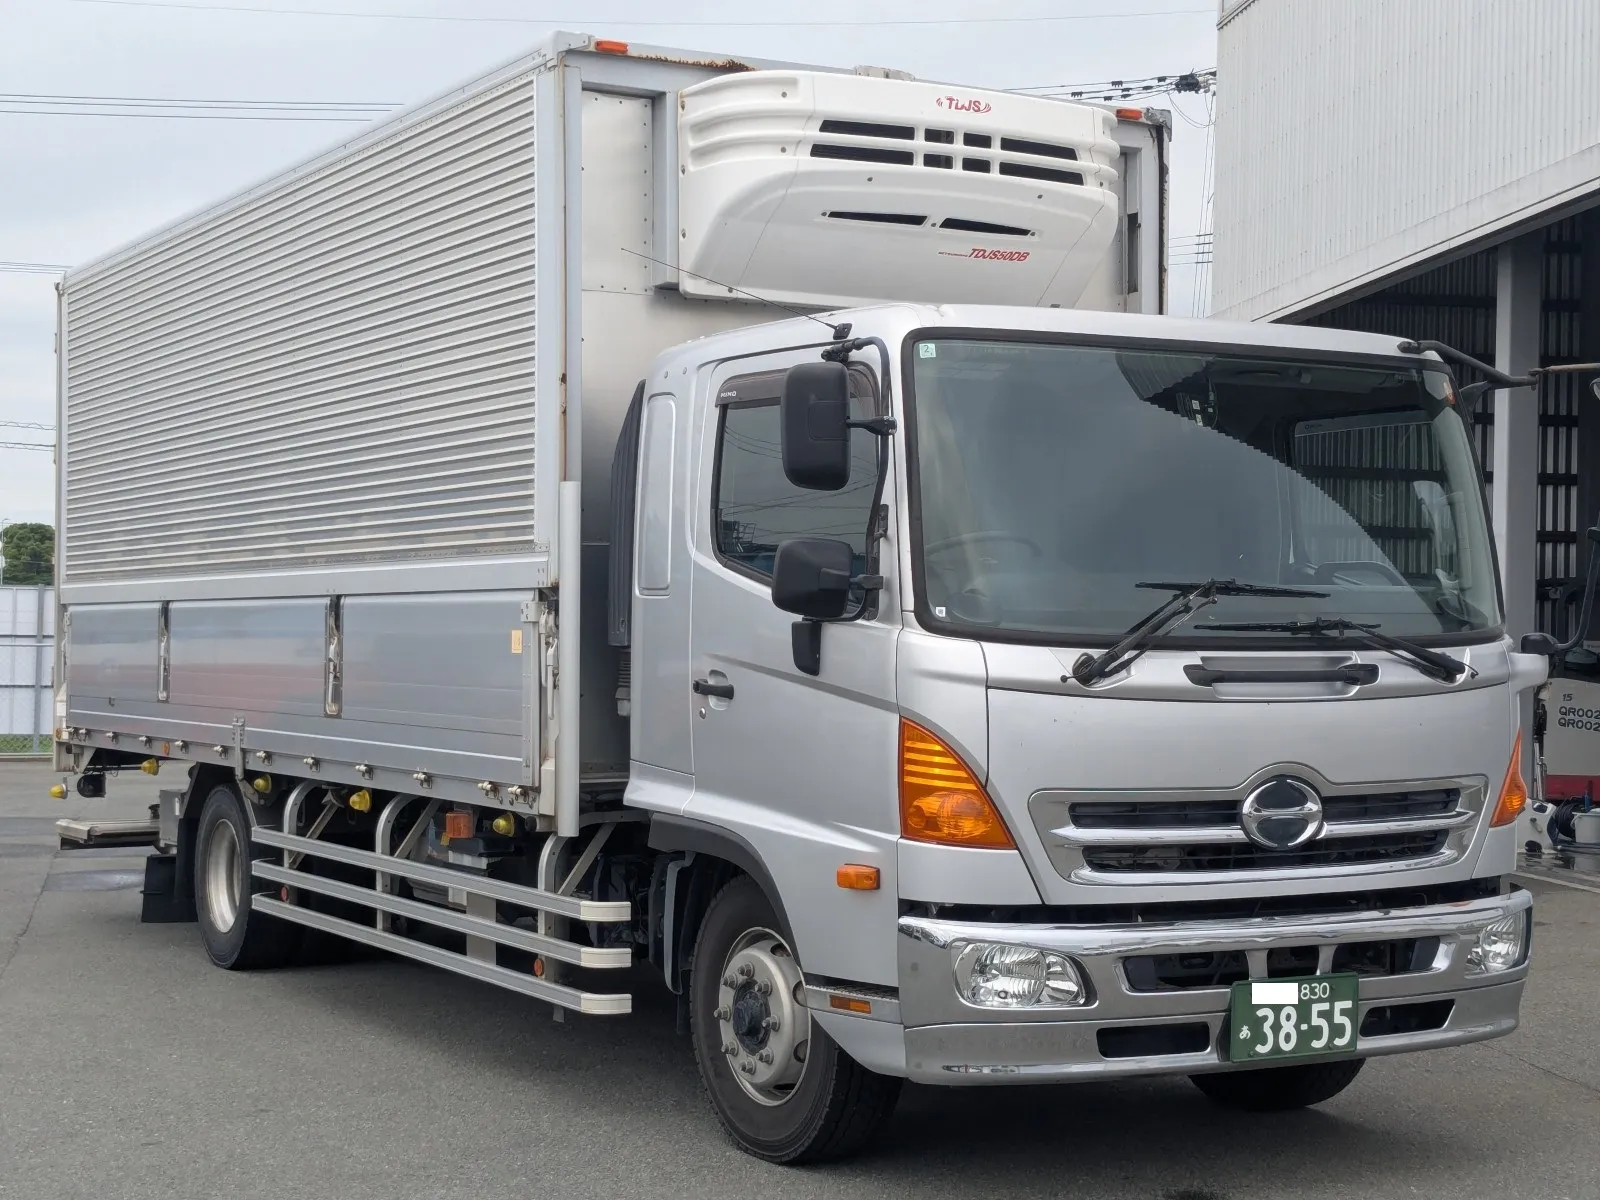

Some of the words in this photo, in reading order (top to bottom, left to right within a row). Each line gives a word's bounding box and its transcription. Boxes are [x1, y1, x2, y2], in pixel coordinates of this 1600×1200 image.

[1562, 693, 1573, 702] 15
[1558, 706, 1600, 720] QR002
[1557, 717, 1600, 732] QR002
[1300, 982, 1330, 1000] 830
[1239, 1025, 1251, 1040] あ
[1254, 1000, 1353, 1054] 38-55
